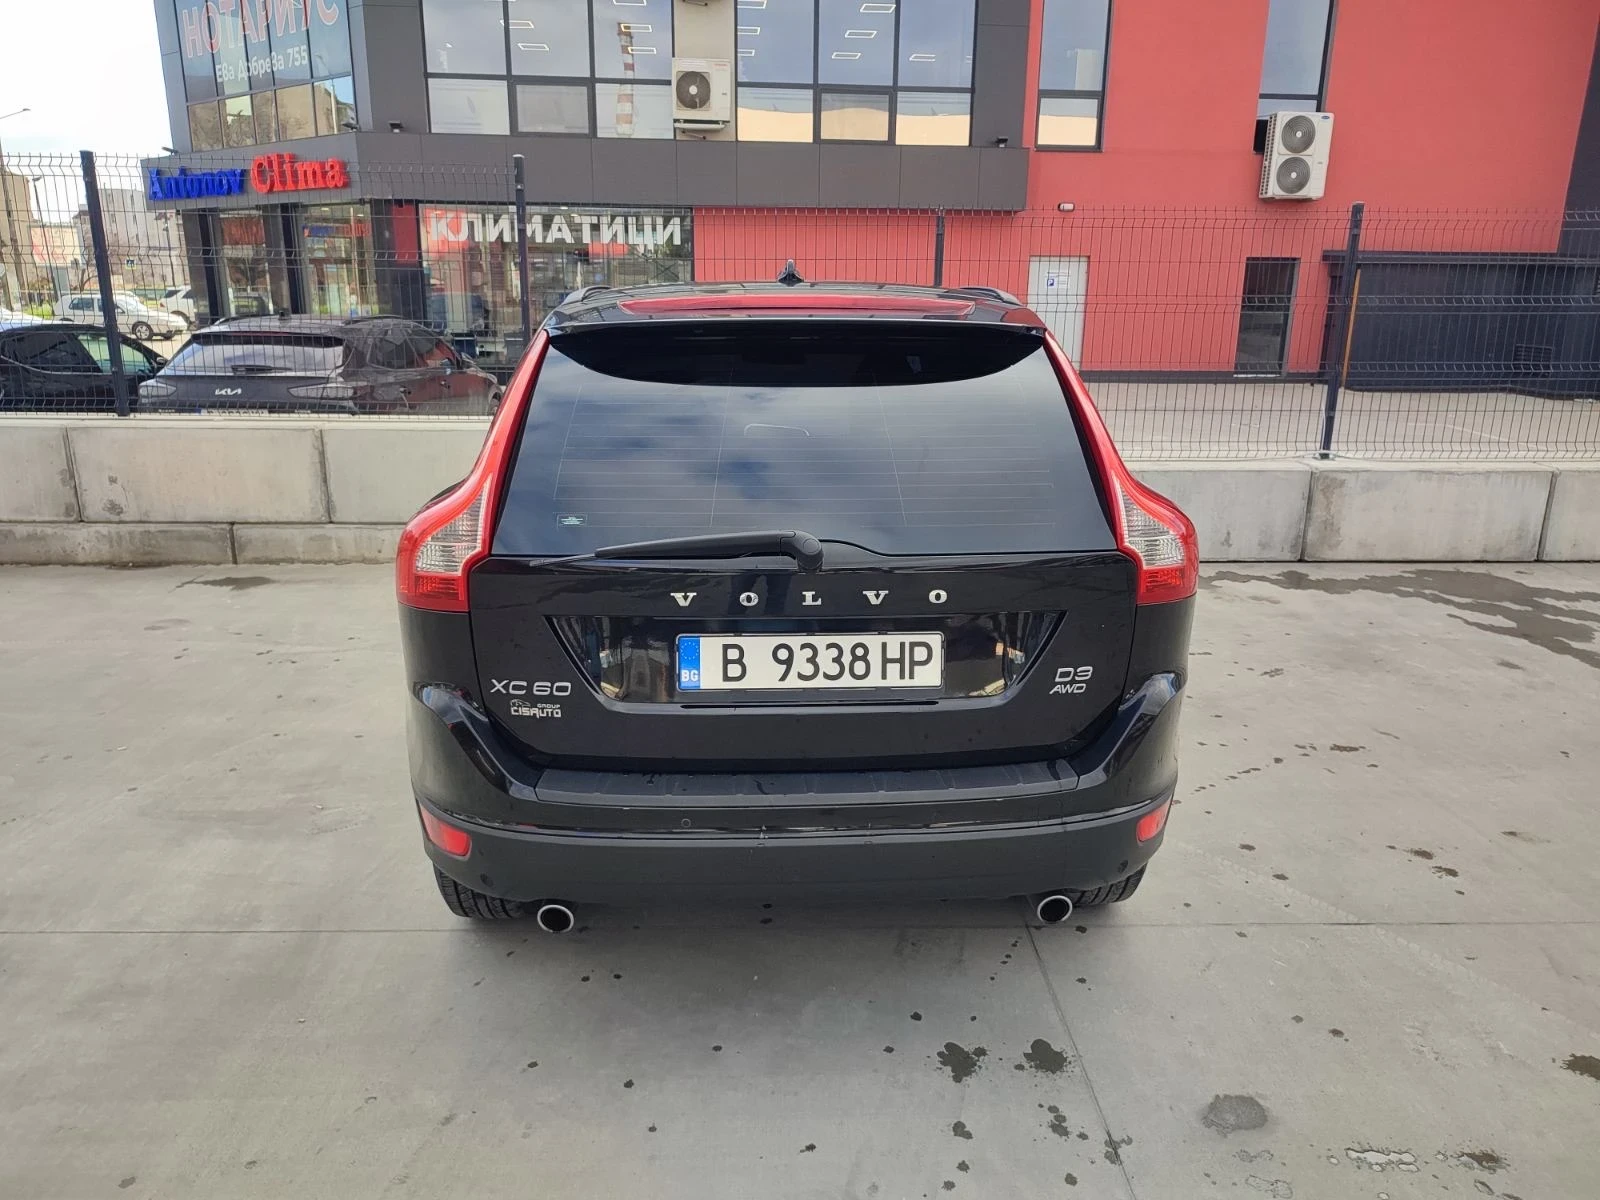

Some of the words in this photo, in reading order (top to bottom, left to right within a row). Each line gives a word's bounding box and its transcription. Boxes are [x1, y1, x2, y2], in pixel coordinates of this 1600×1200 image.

[287, 45, 308, 68] 755
[150, 166, 246, 200] Antonov
[251, 152, 348, 195] Clima
[430, 212, 682, 253] КЛИМАТИЦИ
[670, 589, 948, 608] VOLVO
[721, 643, 747, 682] B
[681, 669, 699, 682] BG
[1054, 666, 1093, 682] D3
[1049, 683, 1087, 694] AWD
